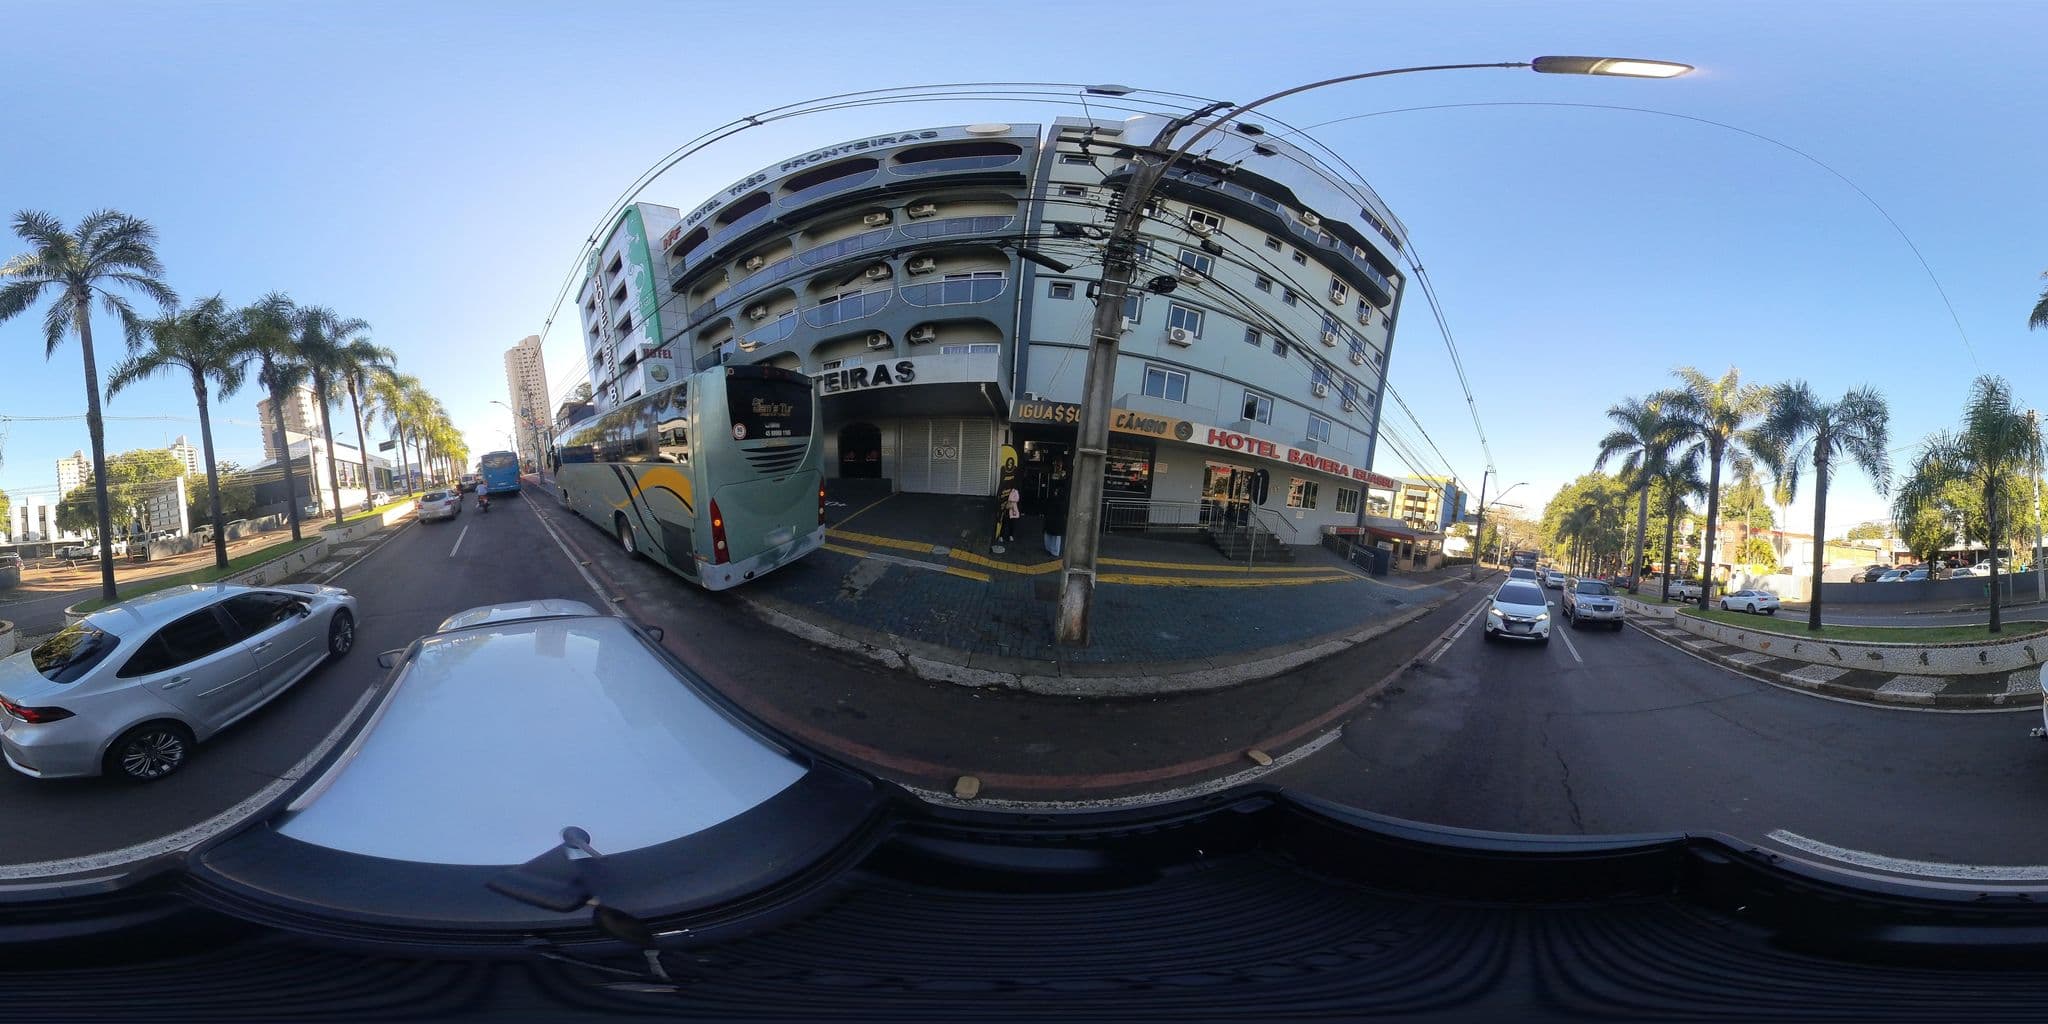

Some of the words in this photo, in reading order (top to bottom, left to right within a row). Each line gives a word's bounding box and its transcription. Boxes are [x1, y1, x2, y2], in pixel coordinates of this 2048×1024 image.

[686, 200, 721, 226] HOTEL
[727, 173, 767, 197] TRÊS
[780, 130, 938, 172] FRONTEIRAS
[643, 348, 673, 360] HOTEL
[1116, 412, 1168, 434] CÂMBIO
[1207, 428, 1281, 460] HOTEL
[1287, 448, 1349, 477] BAVIERA
[1352, 467, 1394, 489] IGUASSU
